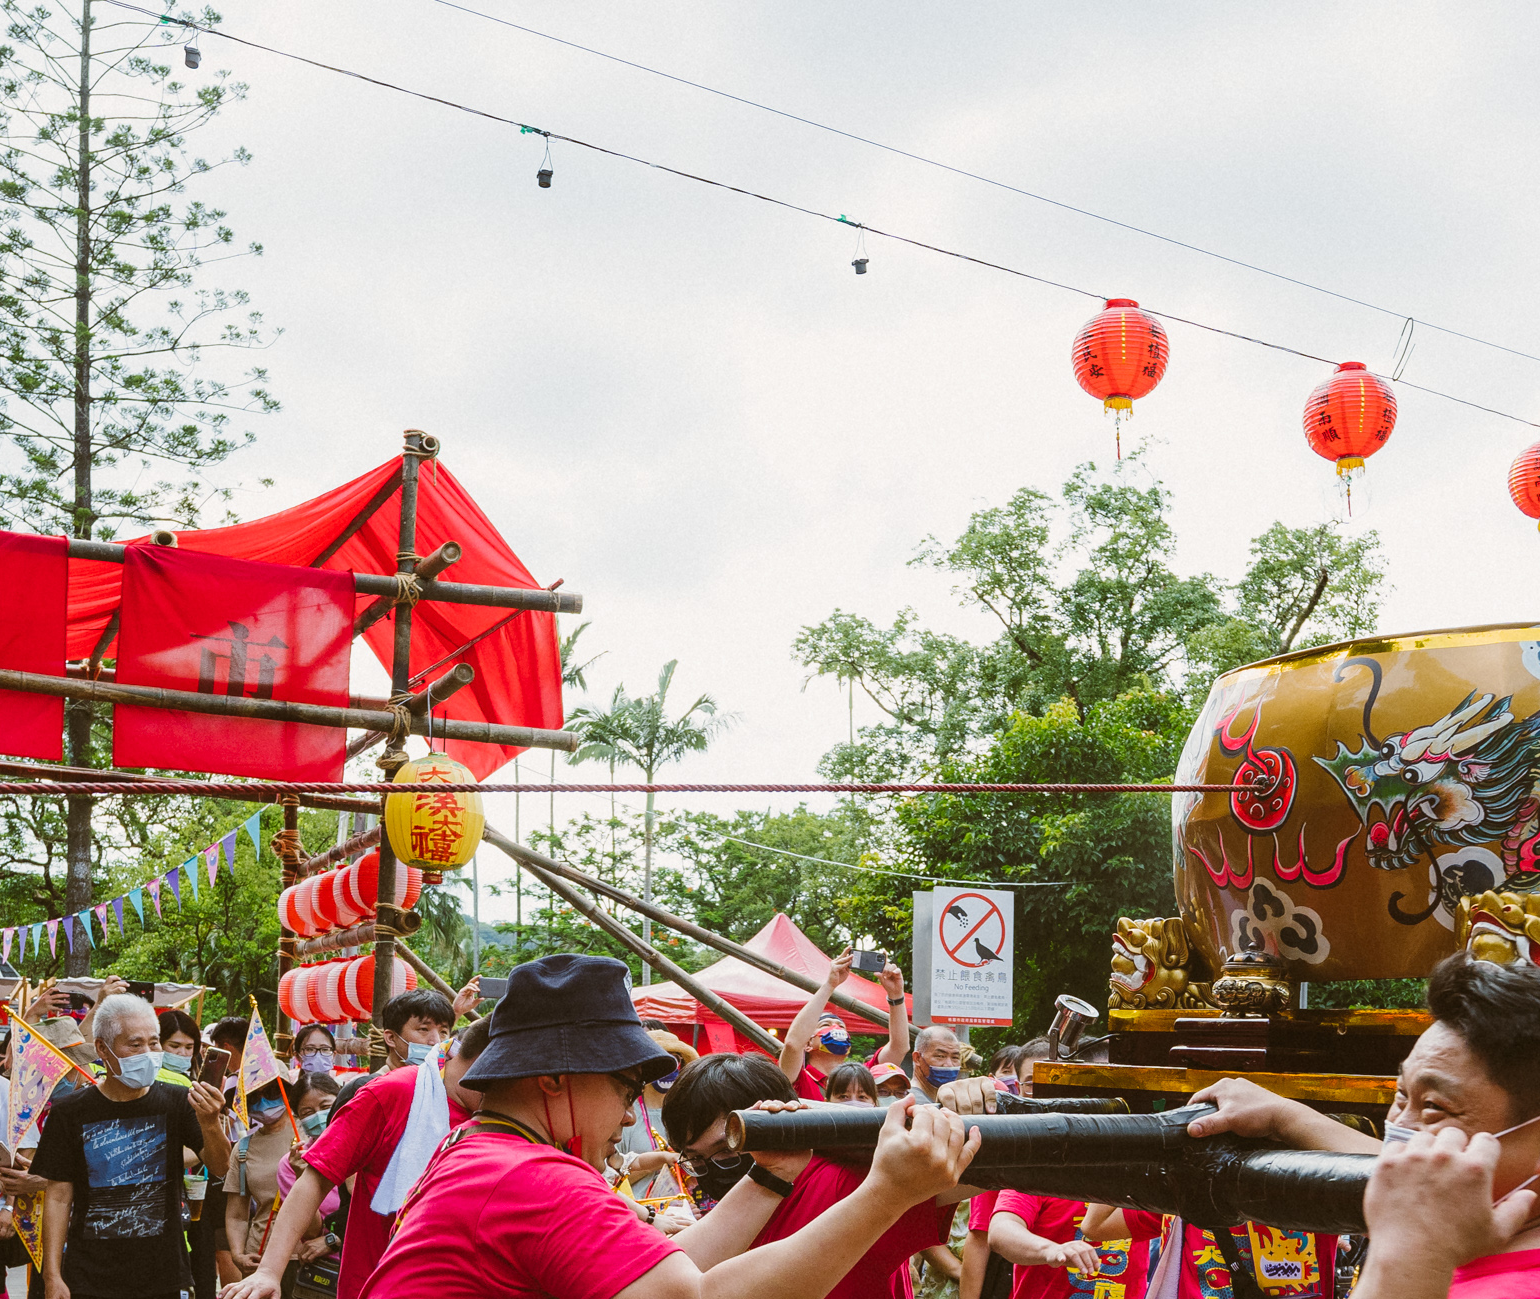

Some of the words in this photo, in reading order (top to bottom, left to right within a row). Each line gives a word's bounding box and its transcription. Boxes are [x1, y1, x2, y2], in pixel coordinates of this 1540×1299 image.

[189, 620, 290, 700] 市
[935, 968, 1008, 984] 禁止餵食禽鳥
[953, 983, 964, 991] No
[965, 983, 990, 993] Feeding
